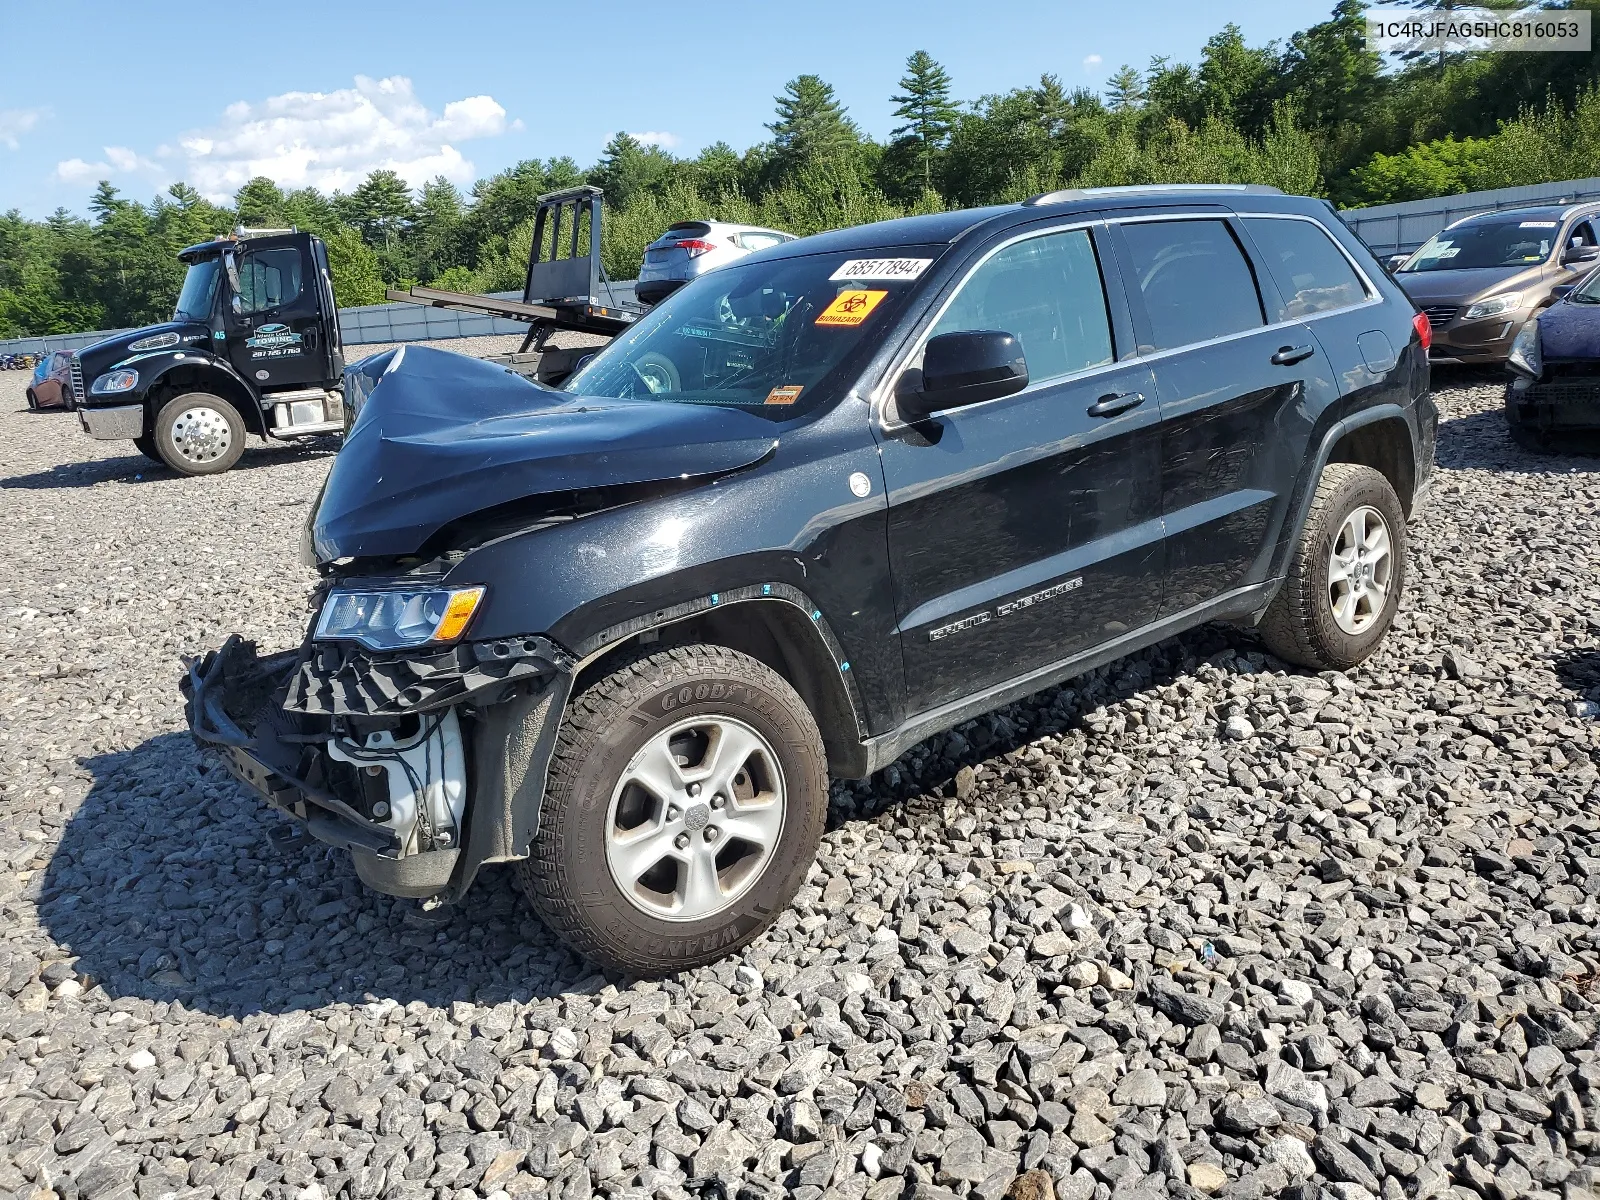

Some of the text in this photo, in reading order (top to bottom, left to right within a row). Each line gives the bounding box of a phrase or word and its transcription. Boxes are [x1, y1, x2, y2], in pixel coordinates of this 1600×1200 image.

[818, 315, 862, 324] BIOHAZARD
[214, 331, 226, 340] 45
[255, 336, 293, 345] TOWING
[929, 576, 1083, 641] GRAND CHEROKEE
[605, 917, 740, 957] WRANGLER
